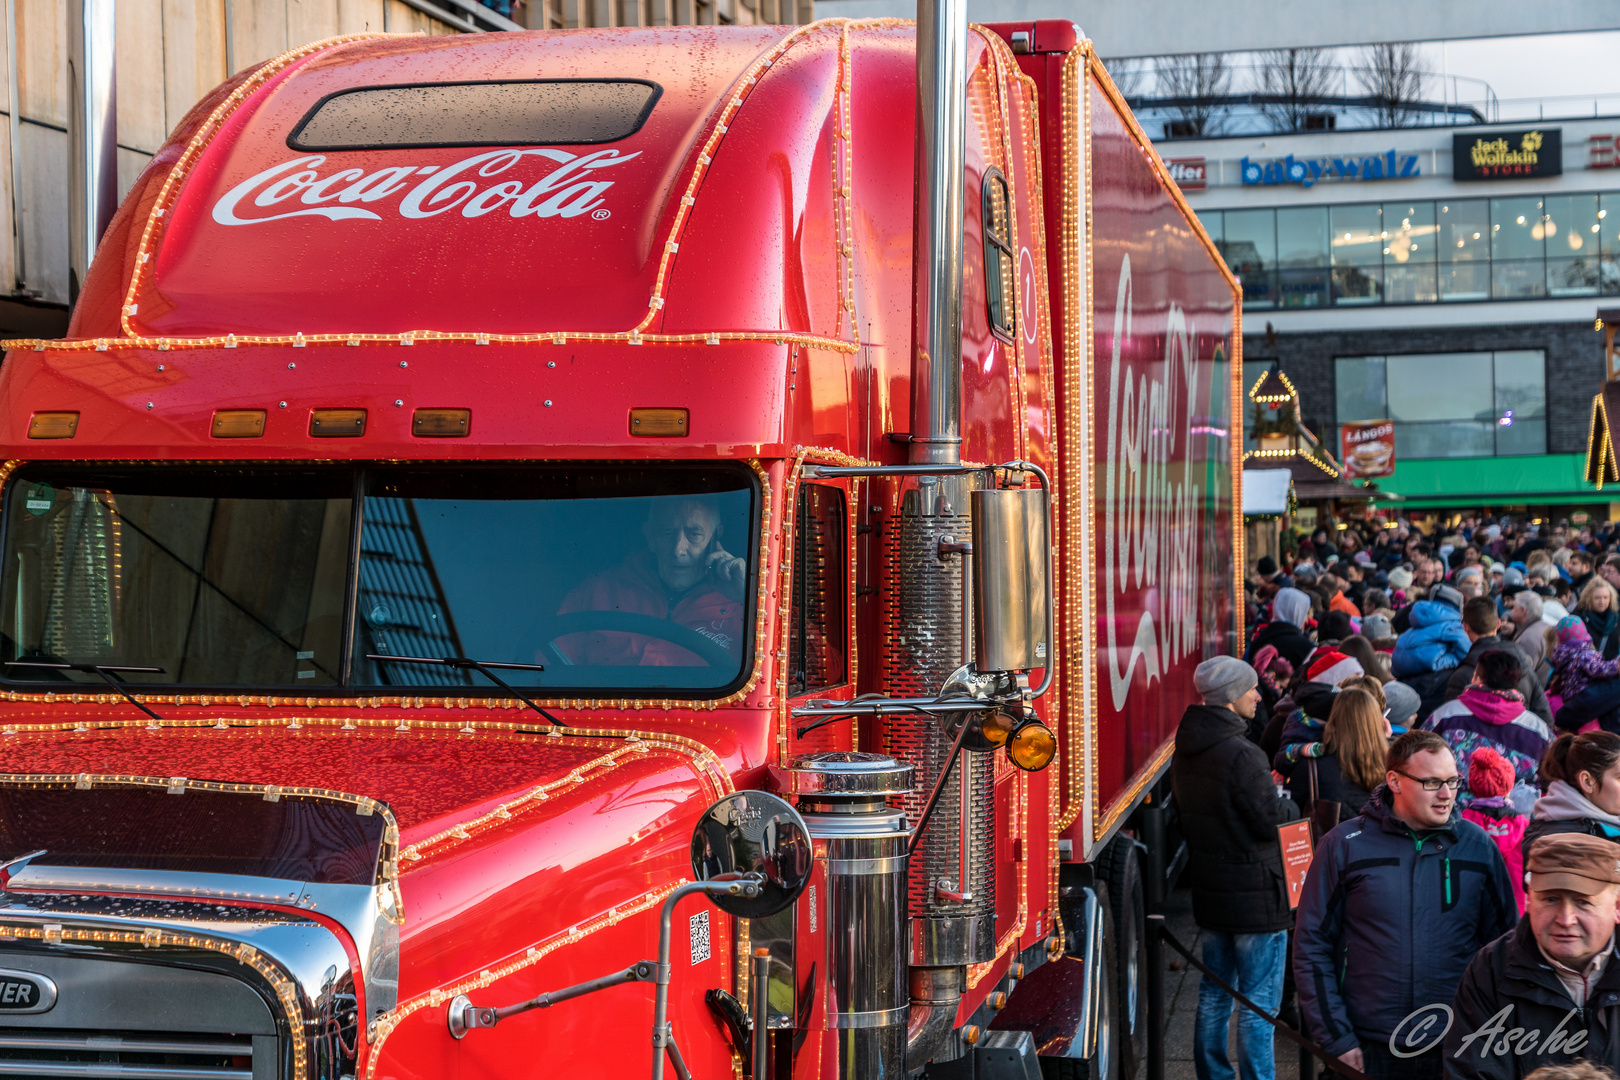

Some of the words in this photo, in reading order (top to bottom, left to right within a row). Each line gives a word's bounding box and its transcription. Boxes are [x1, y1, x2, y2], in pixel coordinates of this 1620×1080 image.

[1471, 138, 1509, 152] Jack
[1471, 150, 1538, 166] Wolfskin
[212, 148, 643, 226] Coca-Cola
[0, 982, 32, 1003] ER
